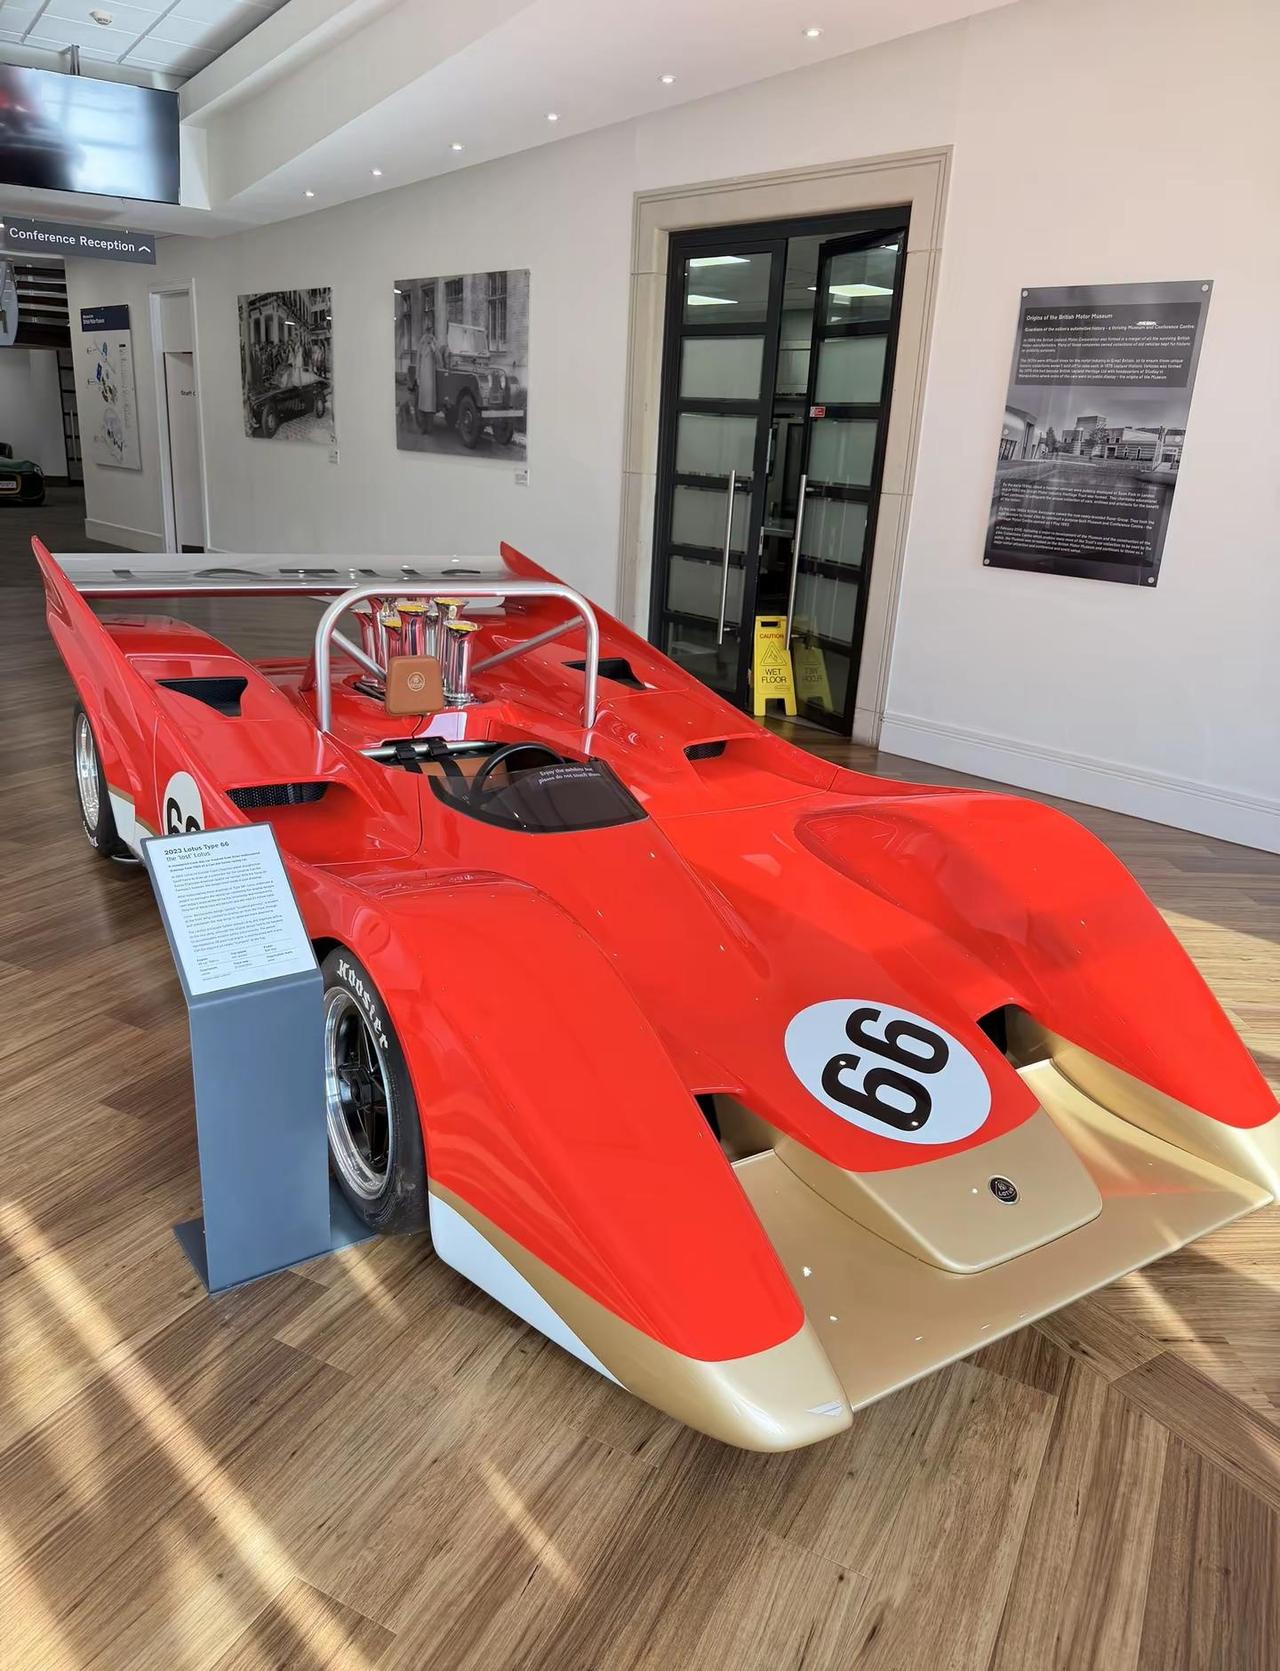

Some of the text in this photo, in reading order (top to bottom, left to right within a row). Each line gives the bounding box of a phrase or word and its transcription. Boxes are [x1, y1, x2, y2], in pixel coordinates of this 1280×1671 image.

[9, 227, 136, 252] Conference Reception
[538, 776, 555, 784] please
[166, 797, 201, 835] 6
[164, 847, 182, 856] 2023
[183, 846, 202, 854] Lotus
[336, 958, 388, 1049] Hoosier
[822, 1007, 950, 1132] 66
